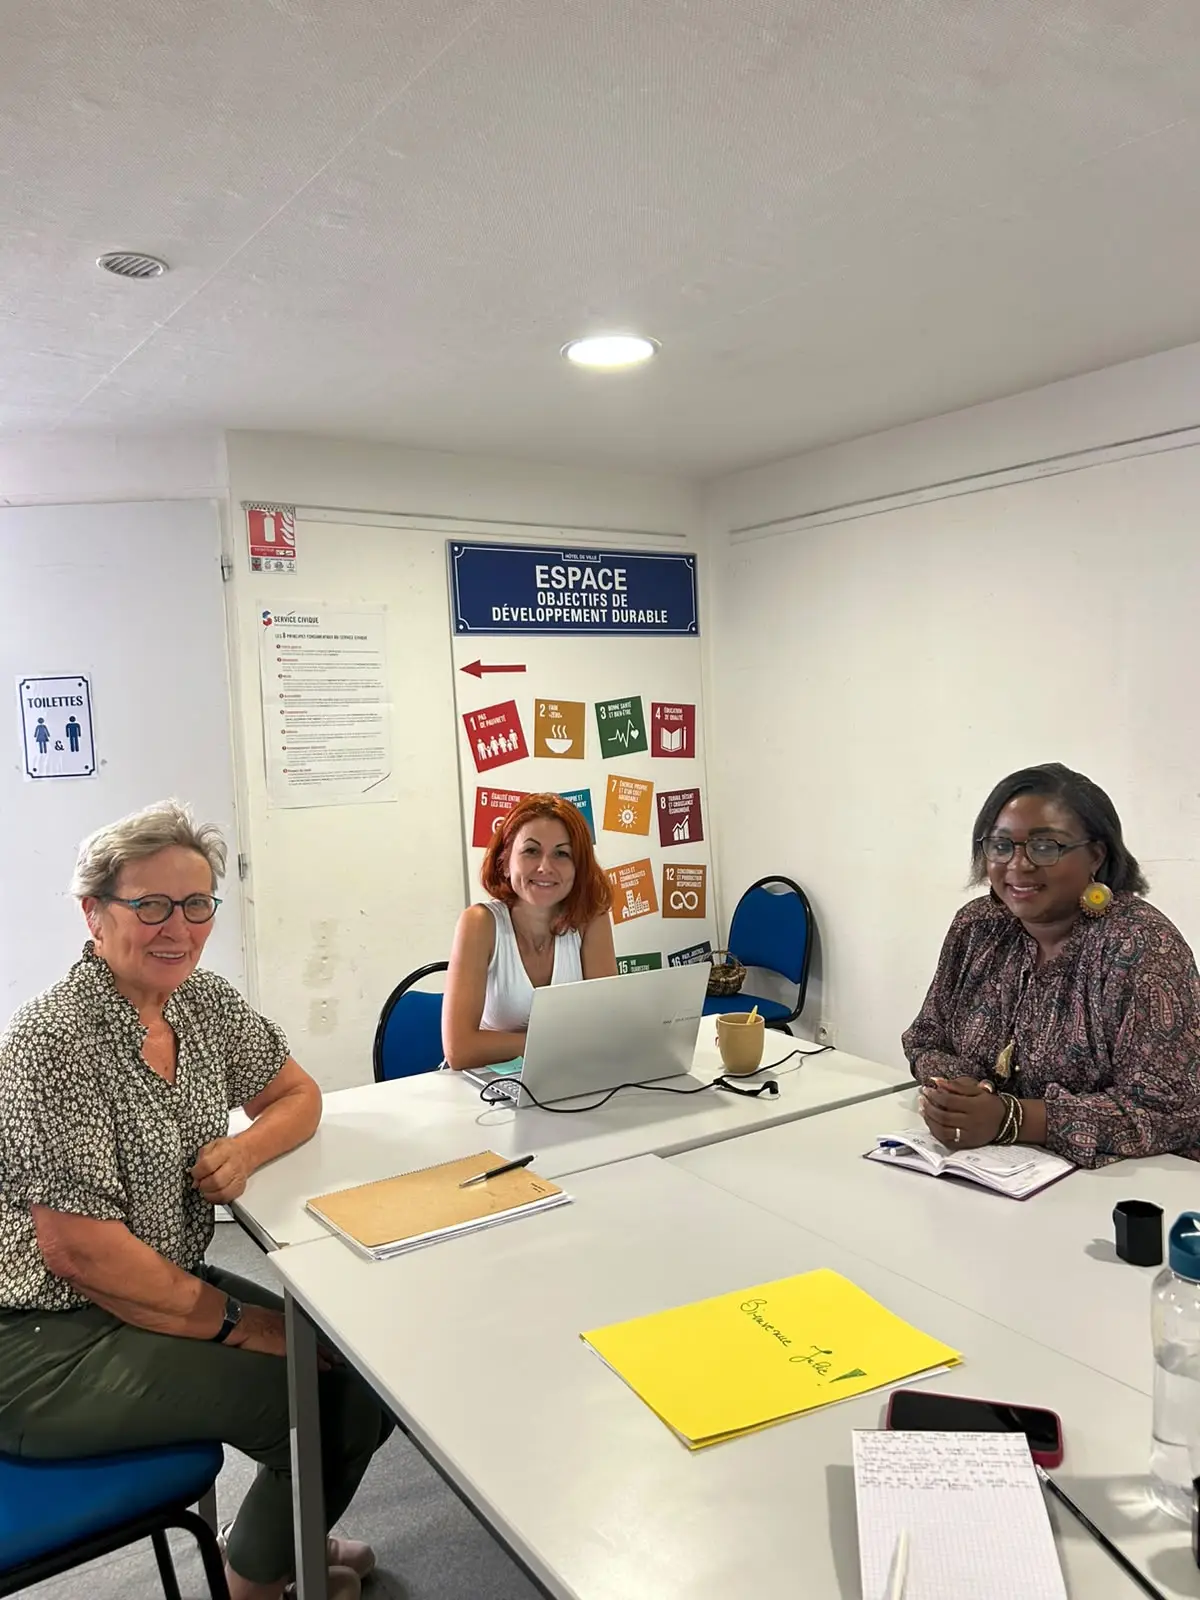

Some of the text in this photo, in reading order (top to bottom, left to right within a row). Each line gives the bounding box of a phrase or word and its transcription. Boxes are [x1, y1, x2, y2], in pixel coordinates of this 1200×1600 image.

[535, 565, 628, 591] ESPACE
[537, 591, 628, 608] OBJECTIFS DE
[274, 616, 296, 624] SERVICE
[492, 603, 668, 624] DÉVELOPPEMENT DURABLE
[28, 696, 83, 708] TOILETTES
[540, 704, 546, 718] 2
[600, 706, 606, 720] 3
[655, 706, 661, 720] 4
[470, 716, 477, 731] 1
[54, 740, 64, 751] &
[611, 779, 617, 793] 7
[480, 792, 488, 806] 5
[660, 796, 666, 810] 8
[608, 871, 618, 885] 11
[665, 868, 675, 881] 12
[618, 960, 628, 974] 15
[671, 956, 681, 968] 16
